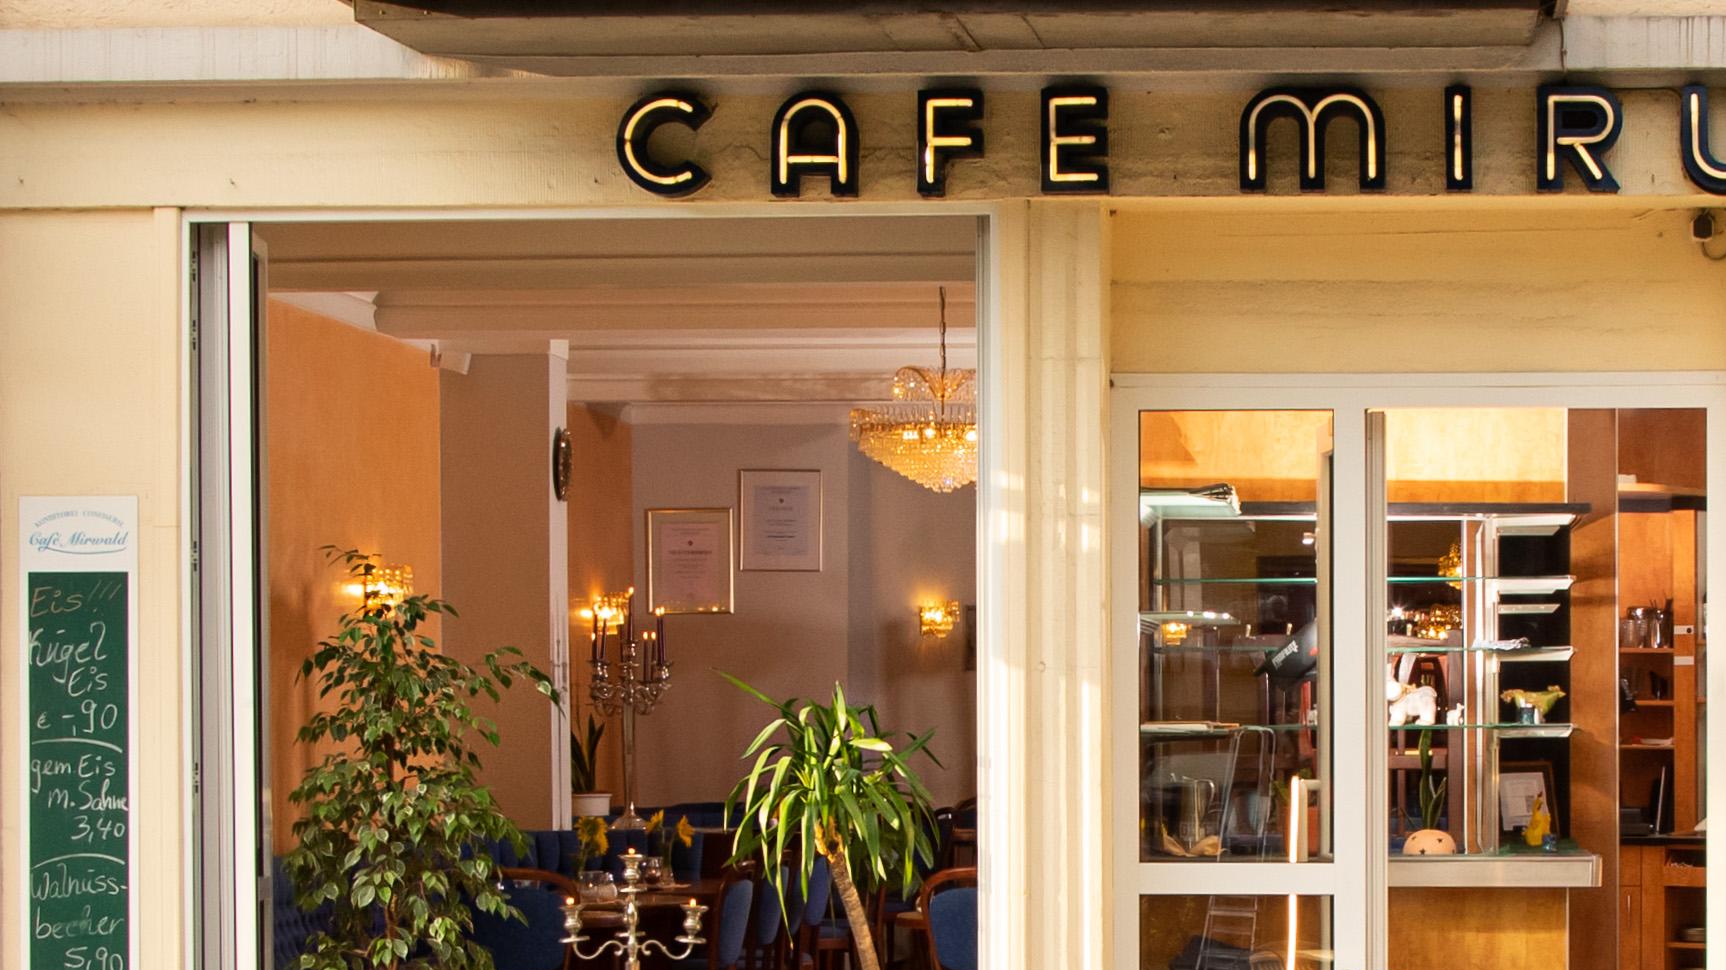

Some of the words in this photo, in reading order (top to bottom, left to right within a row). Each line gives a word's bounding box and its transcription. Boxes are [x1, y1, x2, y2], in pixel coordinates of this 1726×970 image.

[616, 85, 1109, 197] CAFE
[29, 531, 62, 552] Café
[69, 531, 128, 546] Mirwald
[68, 666, 109, 697] Eis
[78, 754, 116, 778] Eis
[78, 778, 129, 811] Sahne
[71, 815, 126, 844] 3,40
